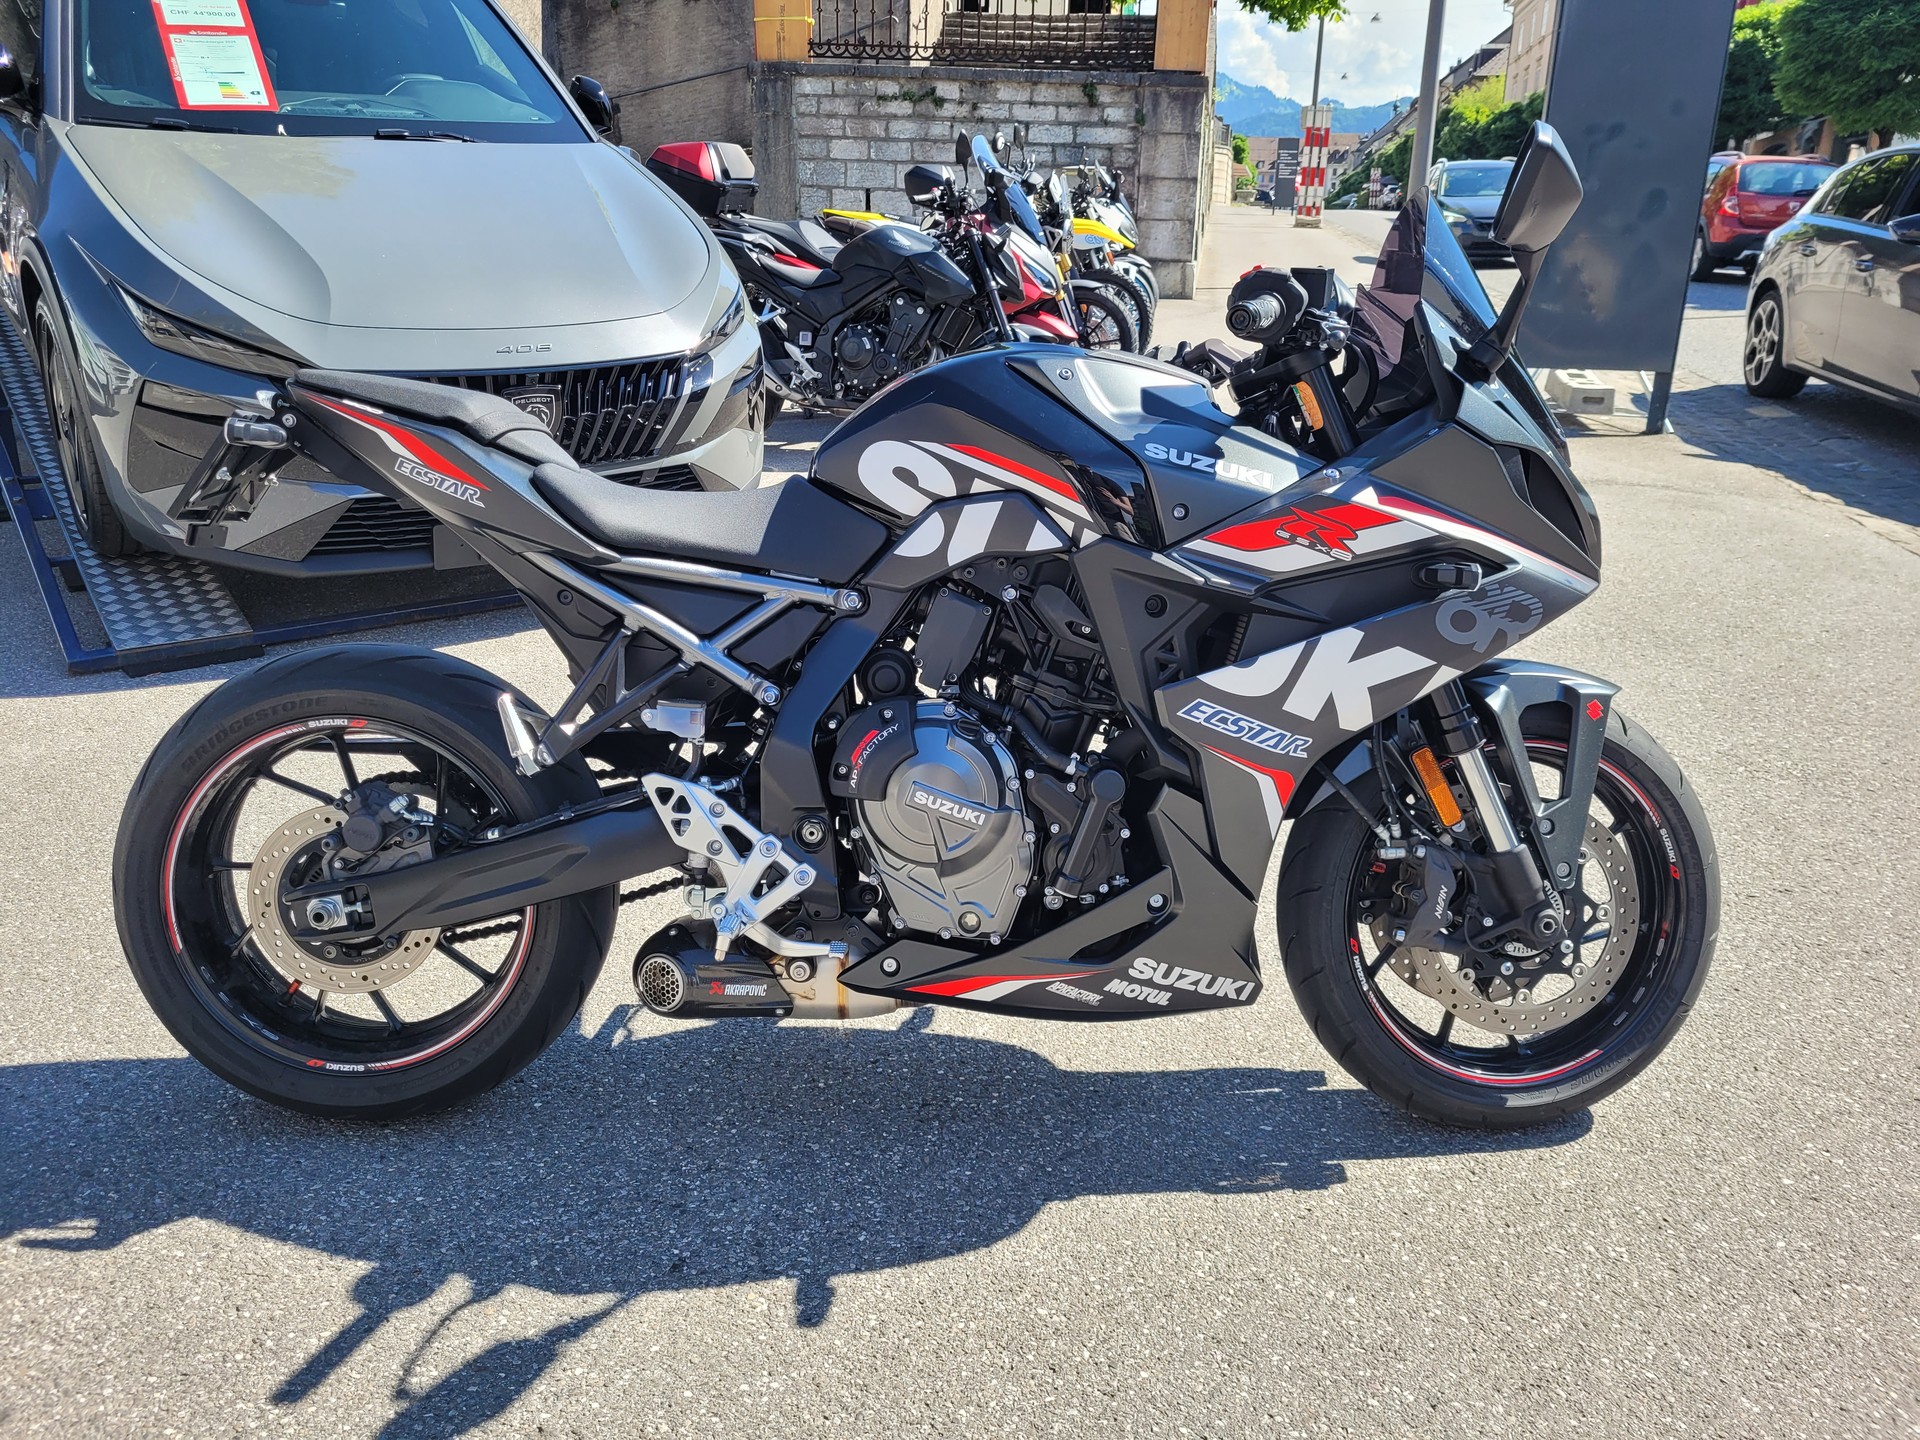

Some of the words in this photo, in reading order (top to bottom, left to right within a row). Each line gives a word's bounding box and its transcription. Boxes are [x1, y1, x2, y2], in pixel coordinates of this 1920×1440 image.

[193, 9, 237, 17] 44'900.00
[888, 239, 910, 250] HONDA
[496, 343, 553, 354] 408
[515, 397, 552, 405] PEUGEOT
[1144, 442, 1274, 490] SUZUKI
[394, 457, 486, 508] ECSTAR
[308, 718, 348, 728] SUZUKI
[1176, 698, 1314, 758] ECSTAR
[913, 791, 986, 826] SUZUKI
[1659, 827, 1677, 864] SUZUKI
[1127, 956, 1256, 1002] SUZUKI
[1353, 955, 1369, 992] SUZUKI
[1103, 978, 1173, 1006] MOTUL
[325, 1062, 366, 1072] SUZUKI
